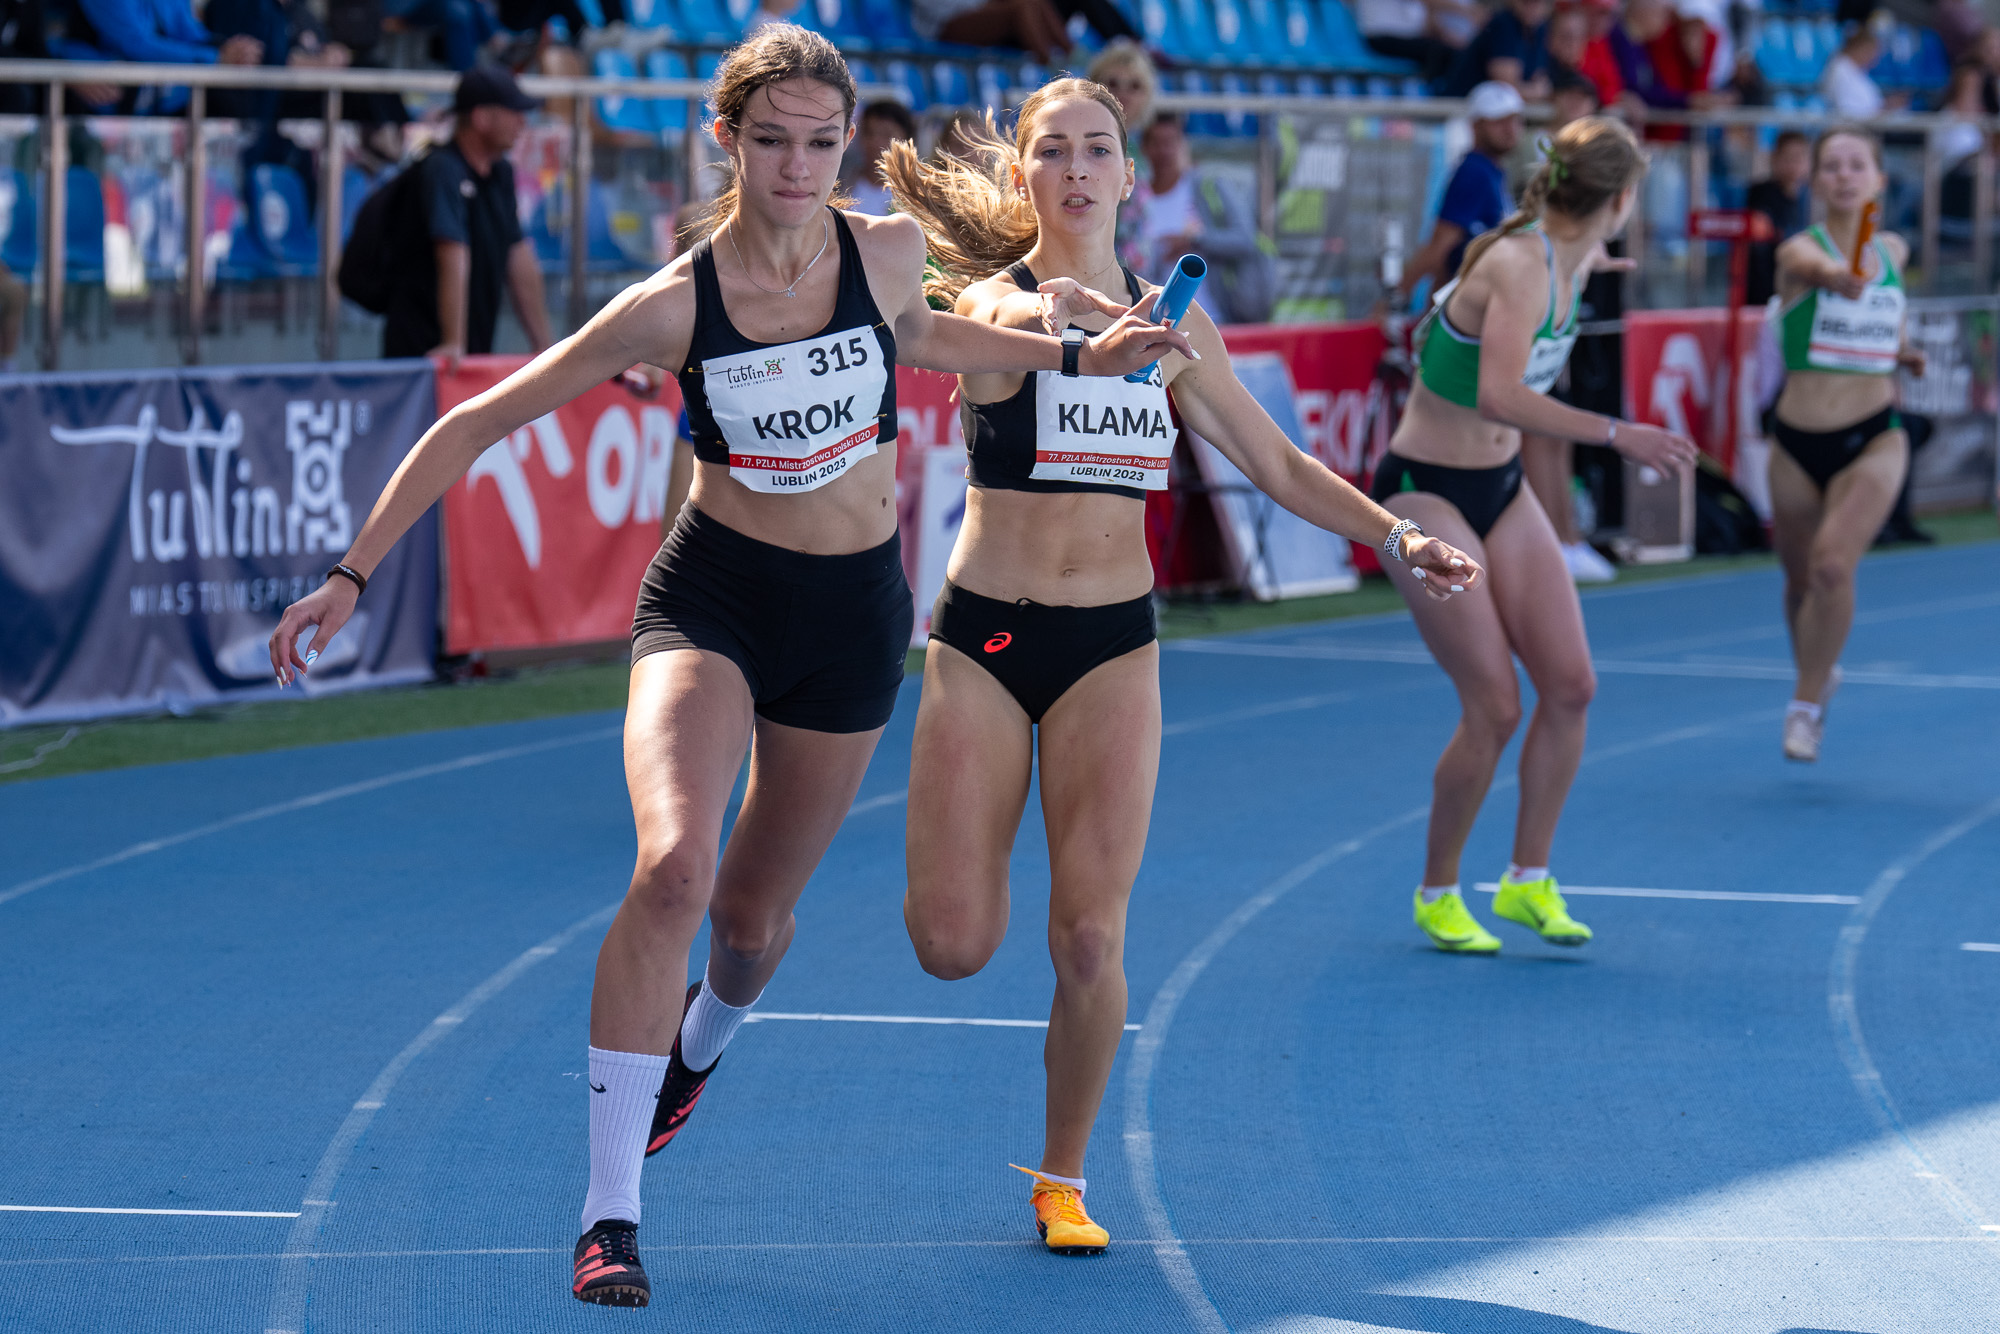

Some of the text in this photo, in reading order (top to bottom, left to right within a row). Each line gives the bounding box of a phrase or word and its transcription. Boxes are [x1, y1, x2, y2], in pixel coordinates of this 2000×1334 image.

[807, 337, 868, 376] 315
[730, 376, 784, 390] MIASTO INSPIRACJI
[752, 395, 856, 440] KROK
[1058, 403, 1167, 439] KLAMA
[741, 429, 871, 470] 77. PZLA Mistrzostwa Polski U20
[1048, 453, 1168, 468] 77. PZLA Mistrzostwa Polski U20
[772, 457, 847, 486] LUBLIN 2023
[1070, 466, 1145, 482] LUBLIN 2023
